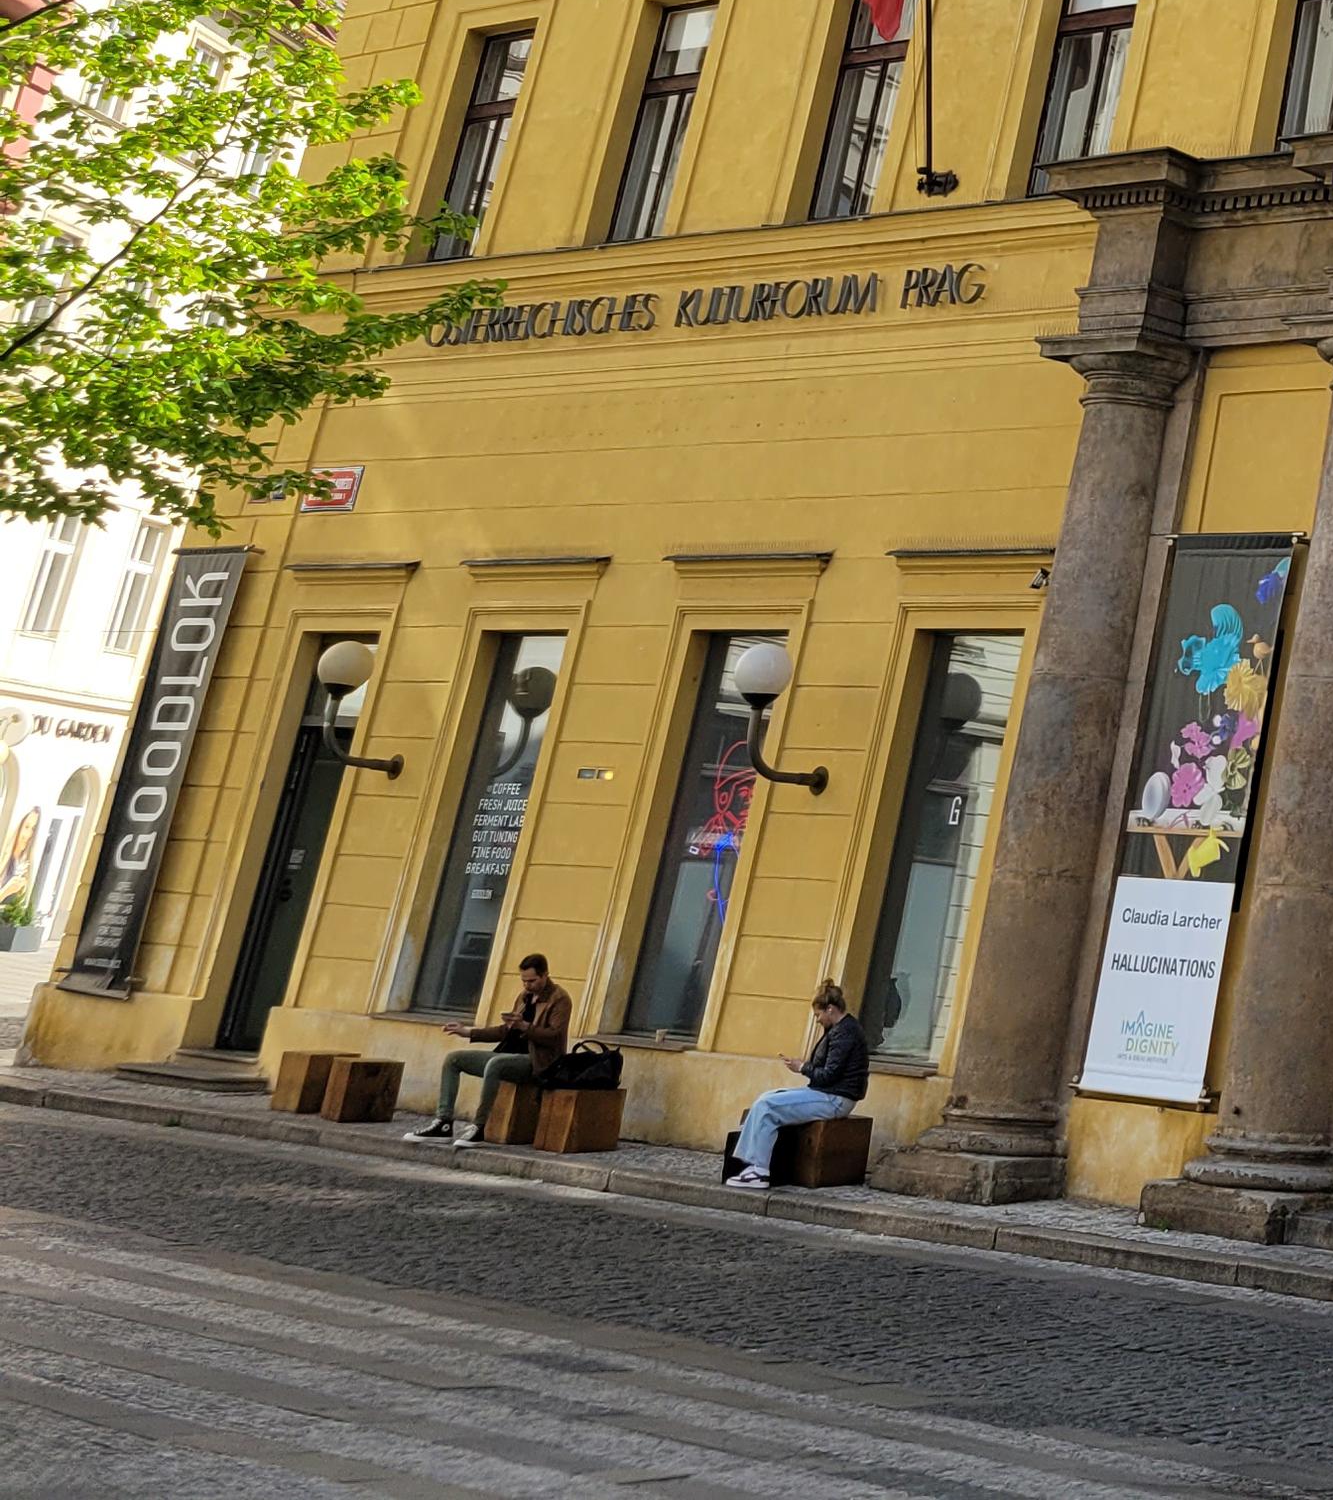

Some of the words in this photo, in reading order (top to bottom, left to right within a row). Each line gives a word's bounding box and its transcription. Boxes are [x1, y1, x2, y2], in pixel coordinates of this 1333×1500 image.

[673, 271, 880, 328] KULTURFORUM
[900, 262, 987, 309] PRAG
[113, 571, 231, 871] GOODLOK
[492, 783, 521, 795] COFFEE
[478, 798, 502, 811] FRESH
[503, 799, 528, 812] JUICE
[473, 814, 509, 827] FERMENT
[509, 815, 526, 828] LAB
[472, 830, 489, 842] GUT
[488, 831, 519, 843] TUNING
[471, 846, 490, 859] FINE
[490, 847, 511, 859] FOOD
[465, 862, 511, 876] BREAKFAST
[1122, 908, 1169, 927] Claudia
[1172, 911, 1223, 930] Larcher
[1111, 953, 1216, 979] HALLUCINATIONS
[1121, 1010, 1175, 1039] IMAGINE
[1125, 1038, 1180, 1057] DIGNITY
